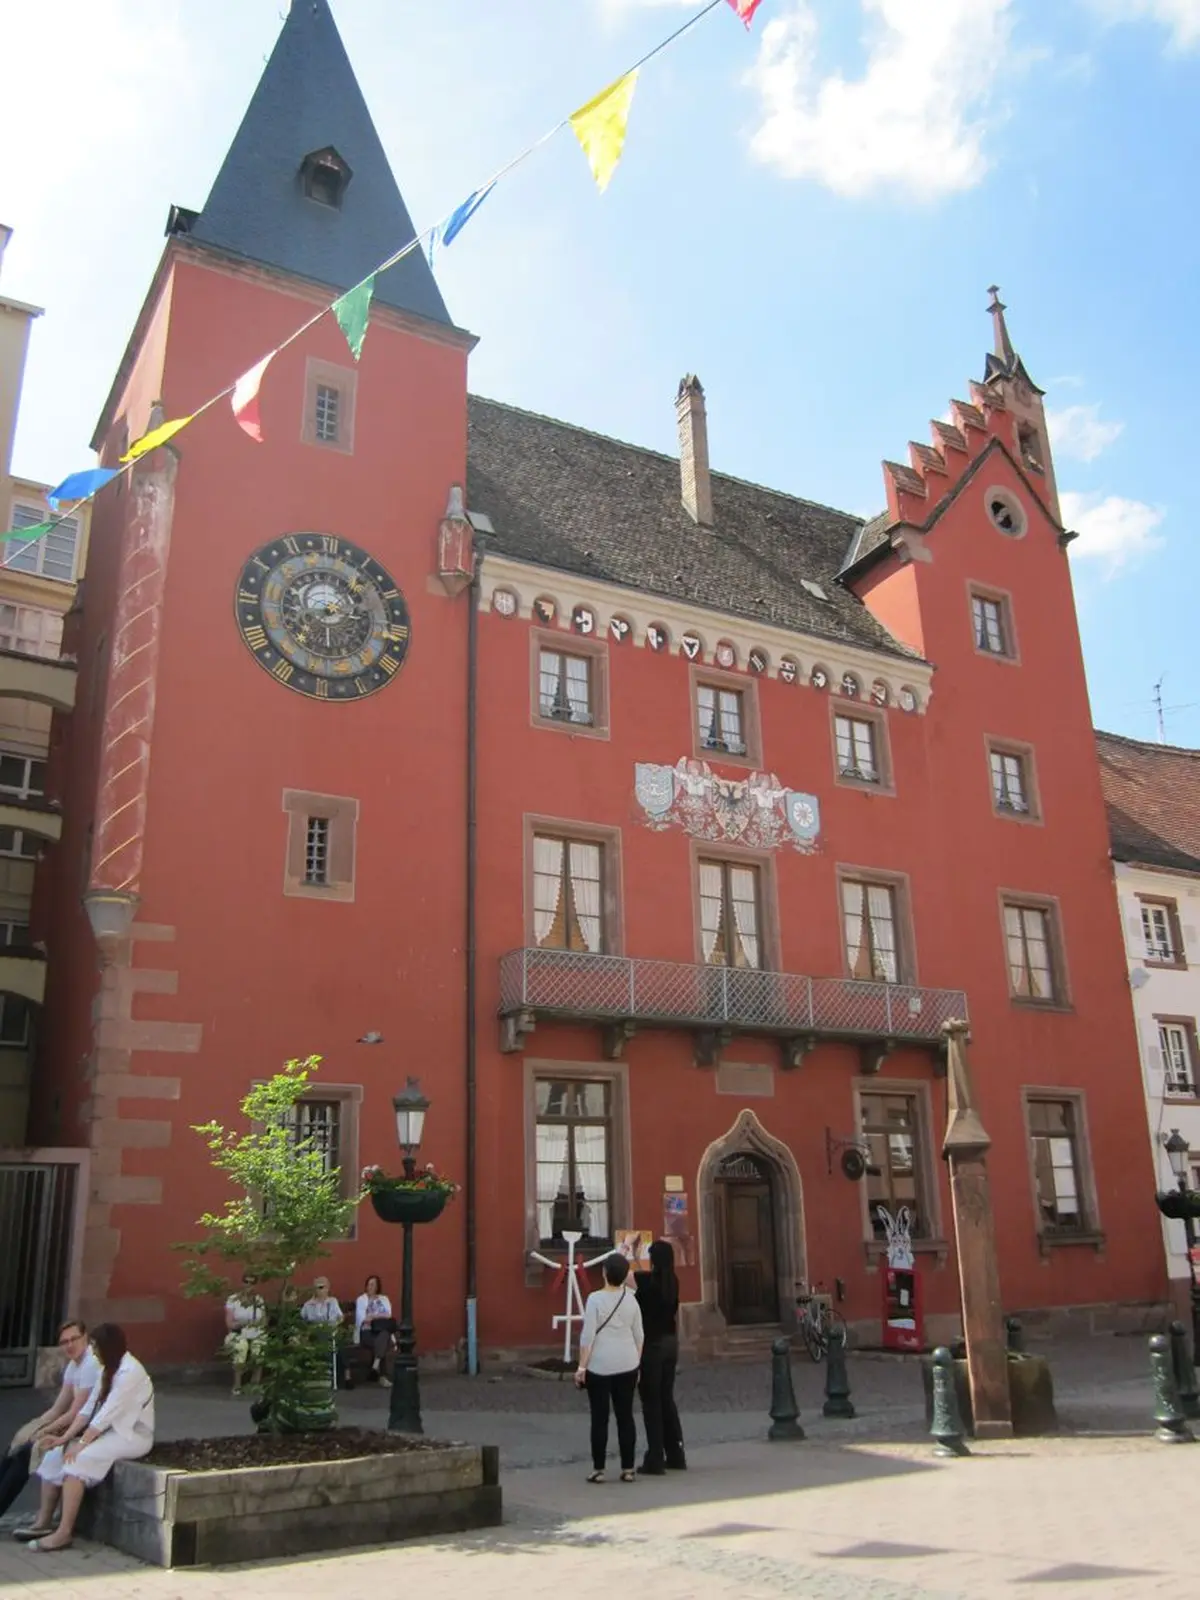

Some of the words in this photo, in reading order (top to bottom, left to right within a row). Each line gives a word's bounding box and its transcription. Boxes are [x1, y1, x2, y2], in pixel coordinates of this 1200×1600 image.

[283, 536, 301, 555] XI
[322, 536, 339, 554] XII
[251, 556, 271, 572] X
[360, 557, 371, 569] I
[239, 588, 259, 605] IX
[383, 588, 400, 600] II
[243, 624, 269, 651] VIII
[272, 658, 295, 682] VII
[378, 653, 400, 676] IIII
[315, 677, 330, 698] VI
